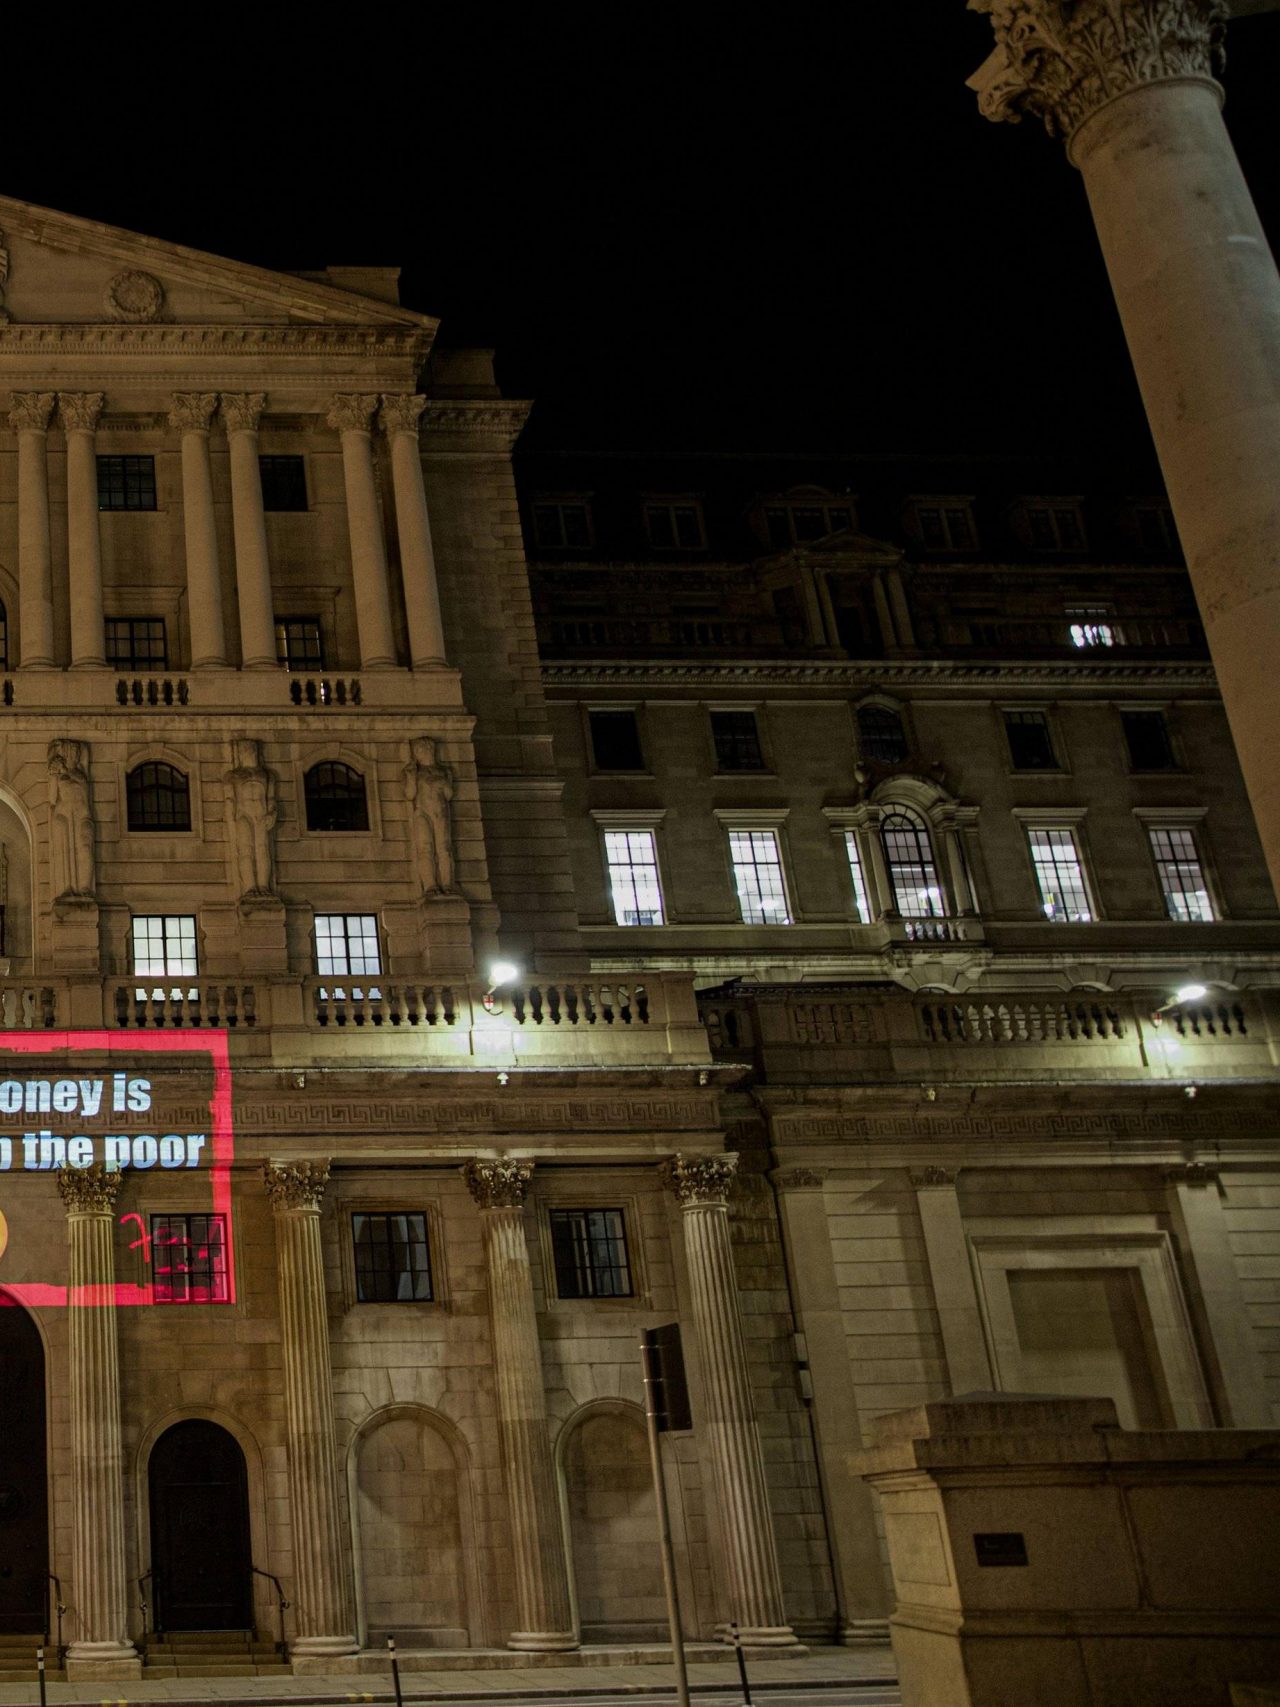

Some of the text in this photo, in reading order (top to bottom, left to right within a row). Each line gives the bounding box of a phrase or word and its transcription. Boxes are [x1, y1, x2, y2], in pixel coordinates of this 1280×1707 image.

[113, 1072, 152, 1112] is
[22, 1130, 94, 1169] the
[104, 1134, 206, 1173] poor
